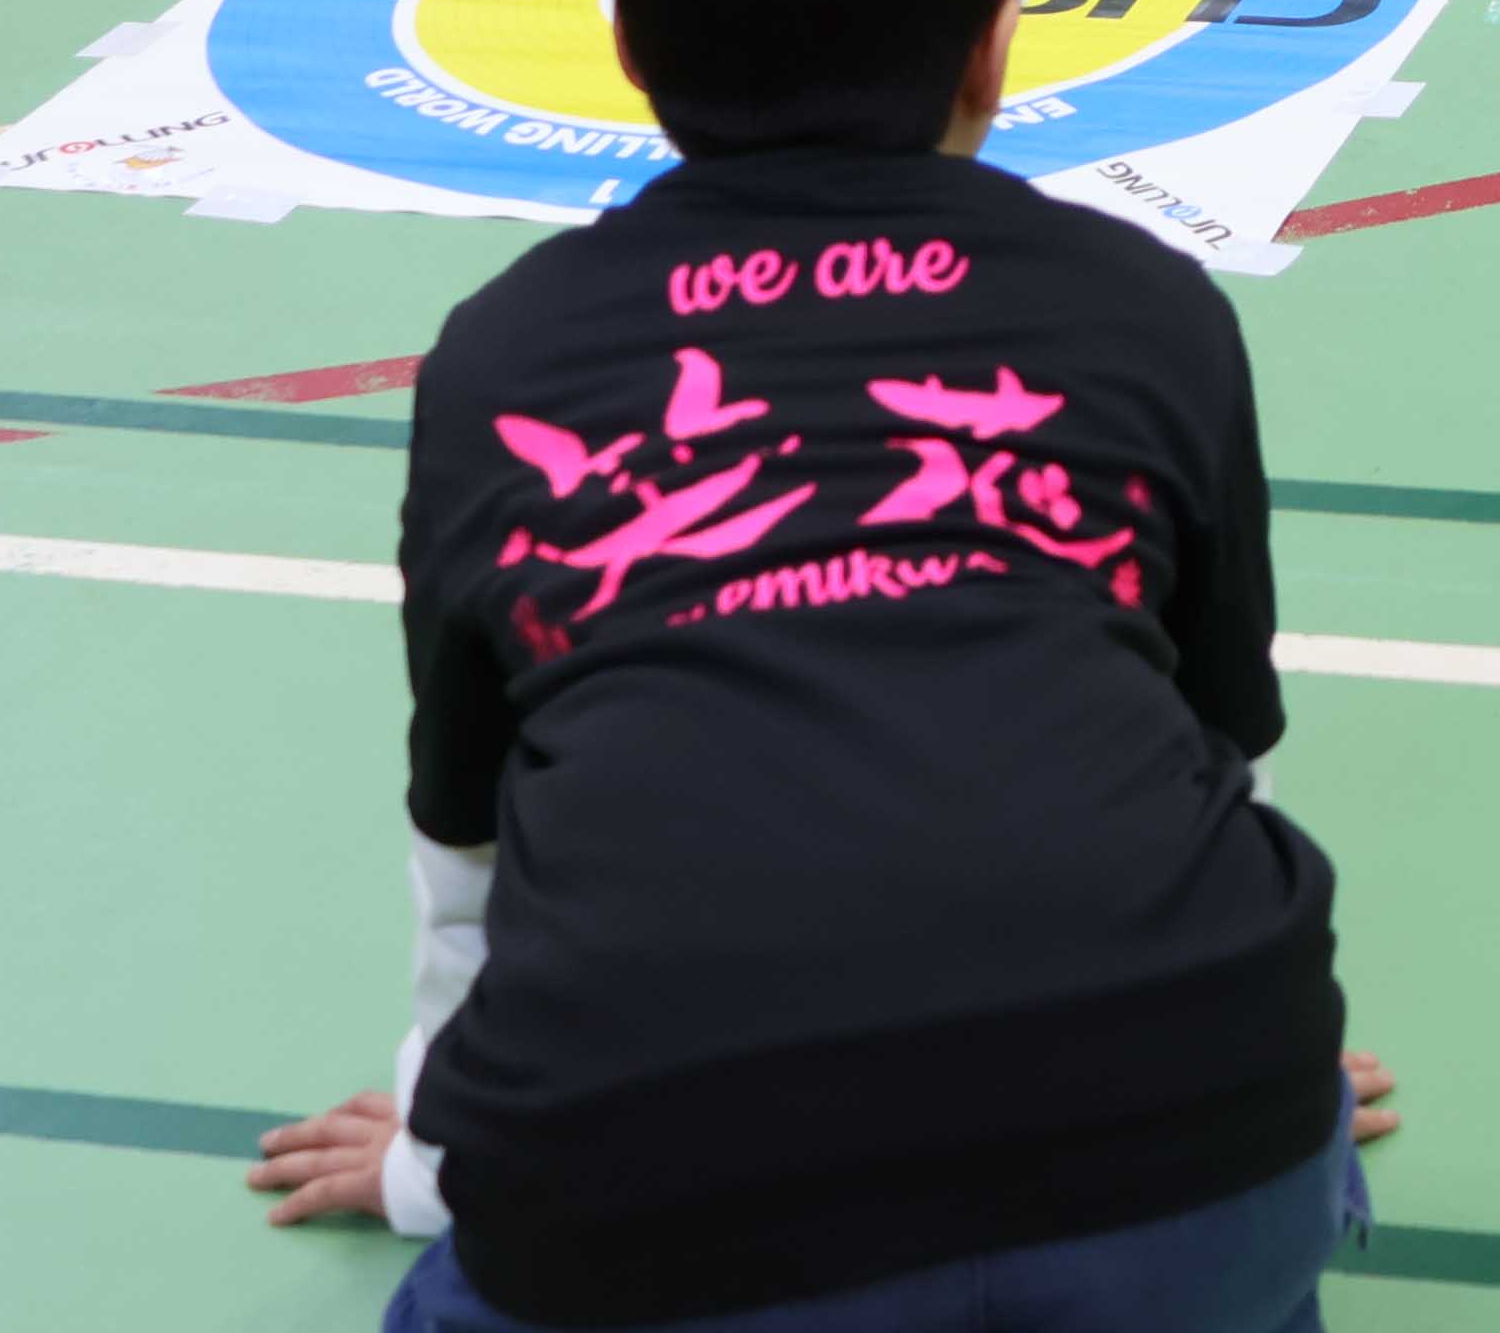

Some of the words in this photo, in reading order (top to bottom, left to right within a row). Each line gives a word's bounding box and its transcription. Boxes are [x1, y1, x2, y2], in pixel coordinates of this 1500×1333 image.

[364, 67, 510, 136] WORLD
[992, 96, 1078, 131] EN
[668, 248, 799, 317] we
[813, 236, 971, 299] are
